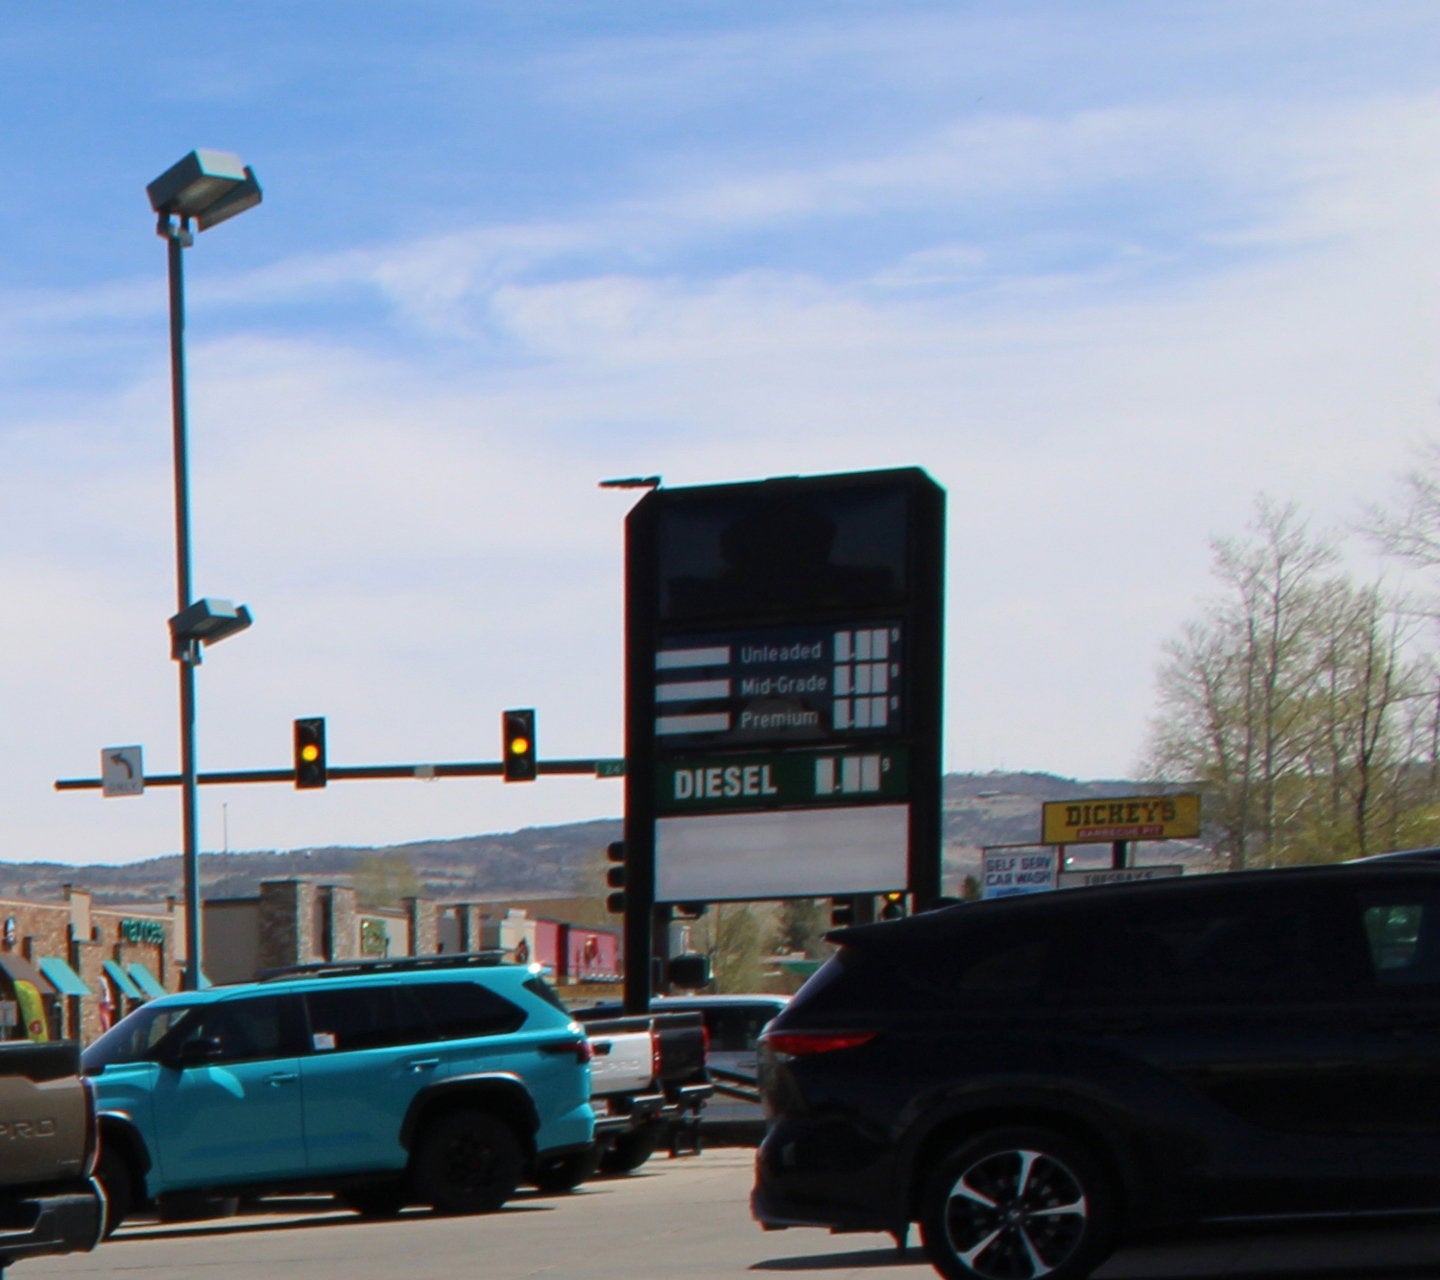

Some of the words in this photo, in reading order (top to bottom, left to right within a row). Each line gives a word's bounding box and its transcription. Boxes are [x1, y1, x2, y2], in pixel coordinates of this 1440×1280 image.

[741, 641, 823, 663] Unleaded
[741, 675, 827, 695] Mid-Grade
[741, 710, 818, 728] Premium
[674, 766, 778, 800] DIESEL
[986, 858, 1015, 873] SELF
[986, 873, 1012, 886] CAR
[1016, 871, 1052, 885] WASH
